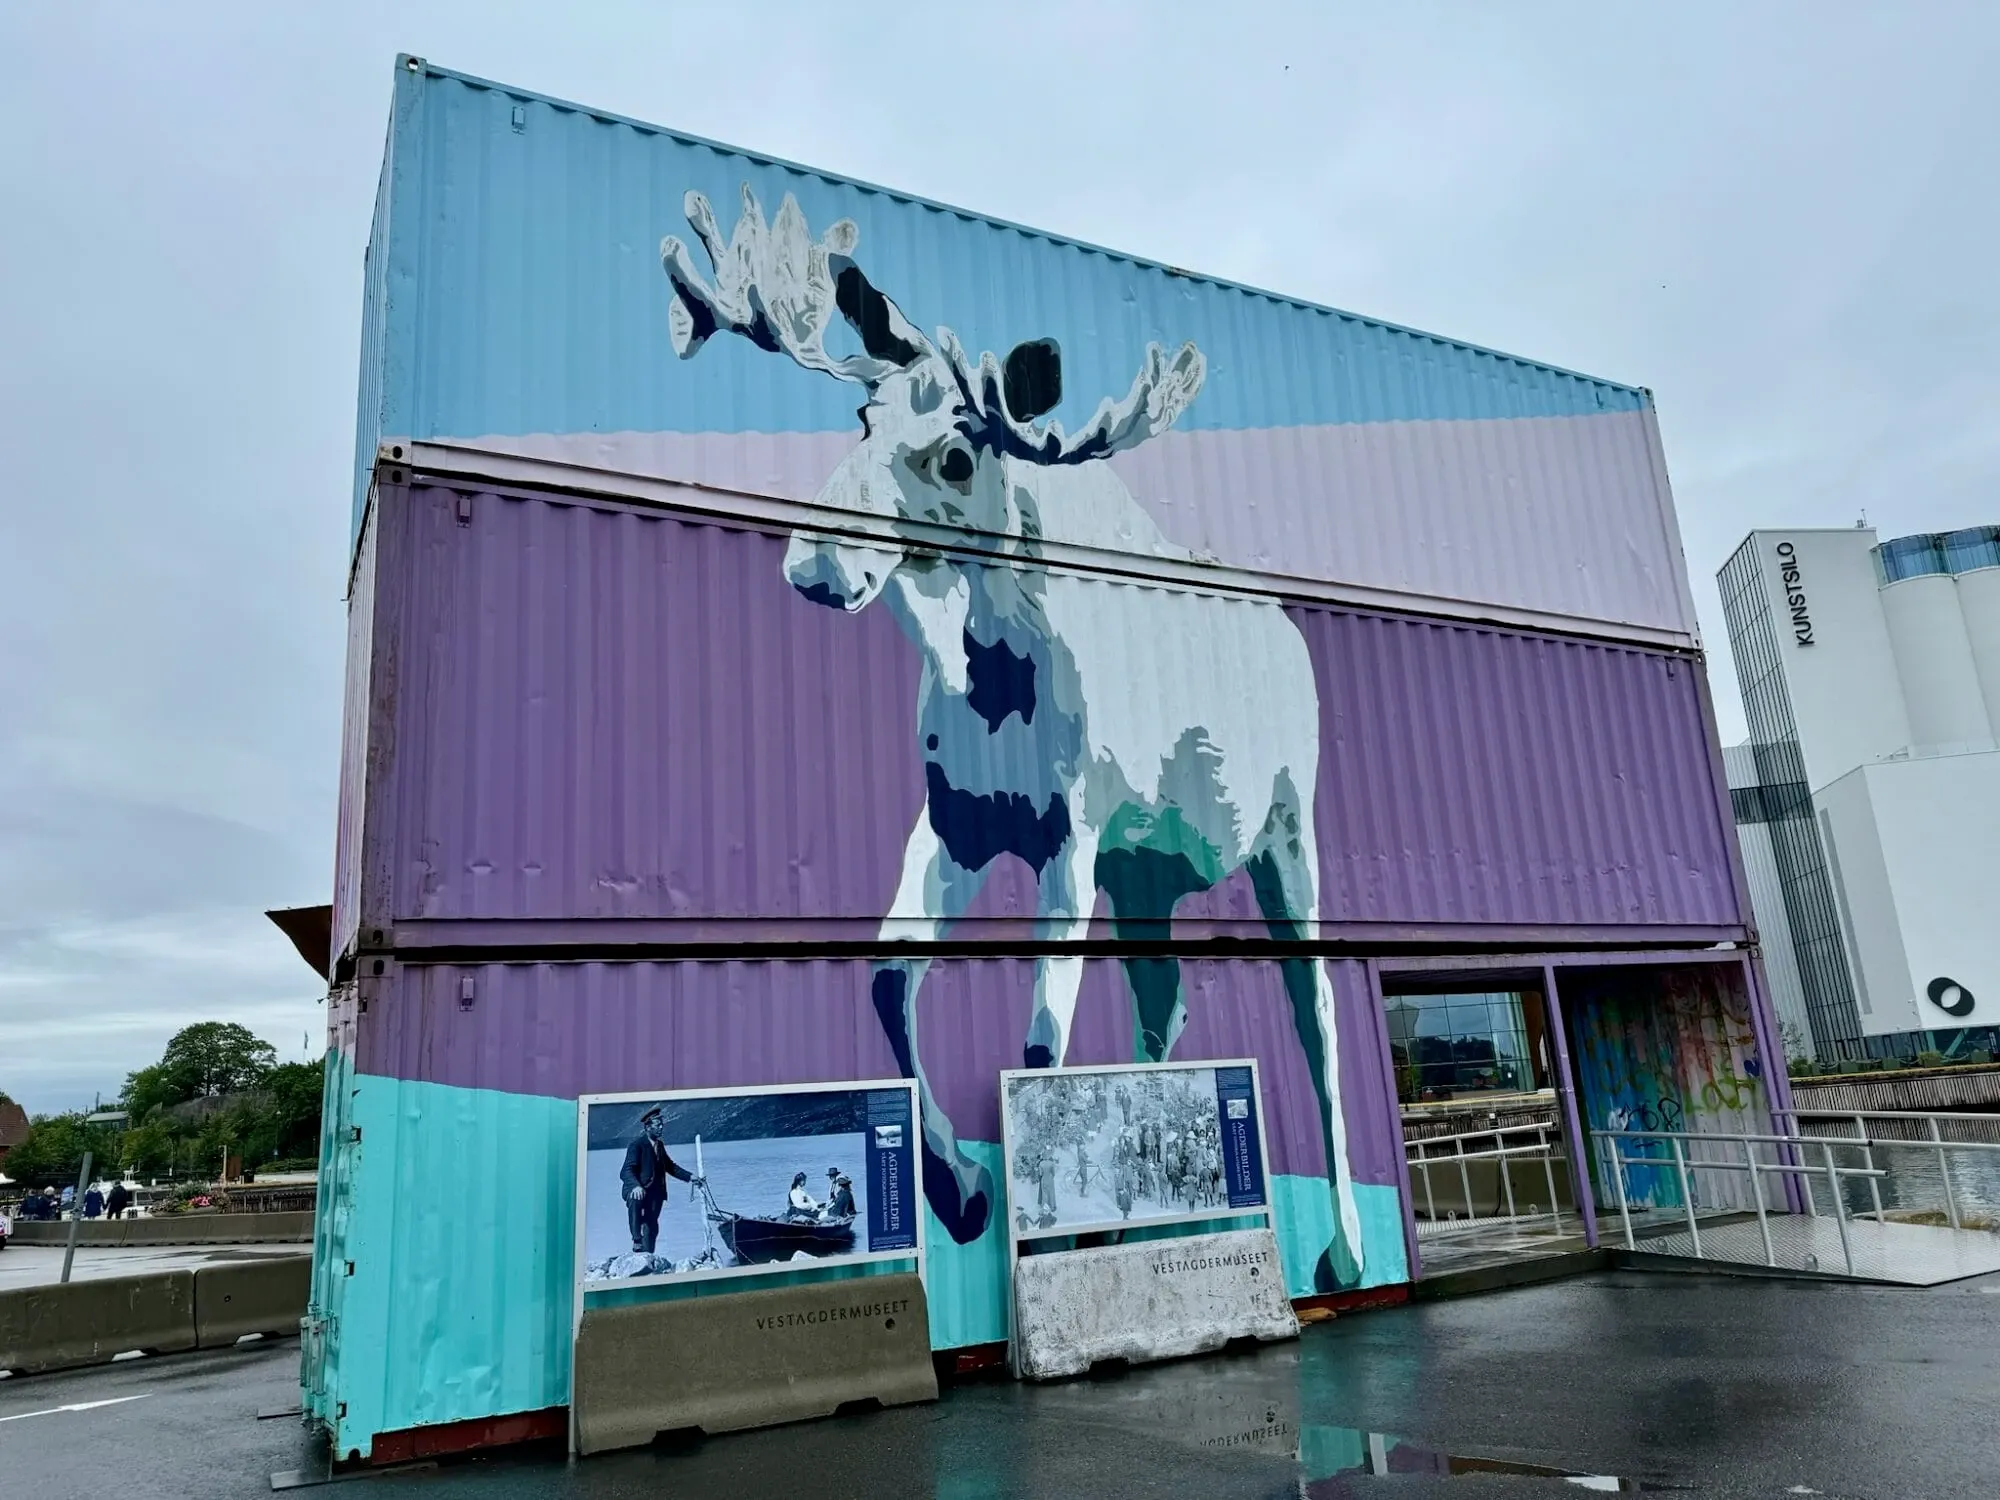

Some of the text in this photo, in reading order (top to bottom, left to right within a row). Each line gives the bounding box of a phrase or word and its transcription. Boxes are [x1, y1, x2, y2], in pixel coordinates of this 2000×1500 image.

[1776, 542, 1815, 646] KUNSTSILO
[1237, 1121, 1251, 1191] AGDERBILDER
[888, 1151, 900, 1232] AGDERBILDER
[1152, 1252, 1268, 1275] VESTAGDERMUSEET
[756, 1300, 909, 1330] VESTAGDERMUSEET
